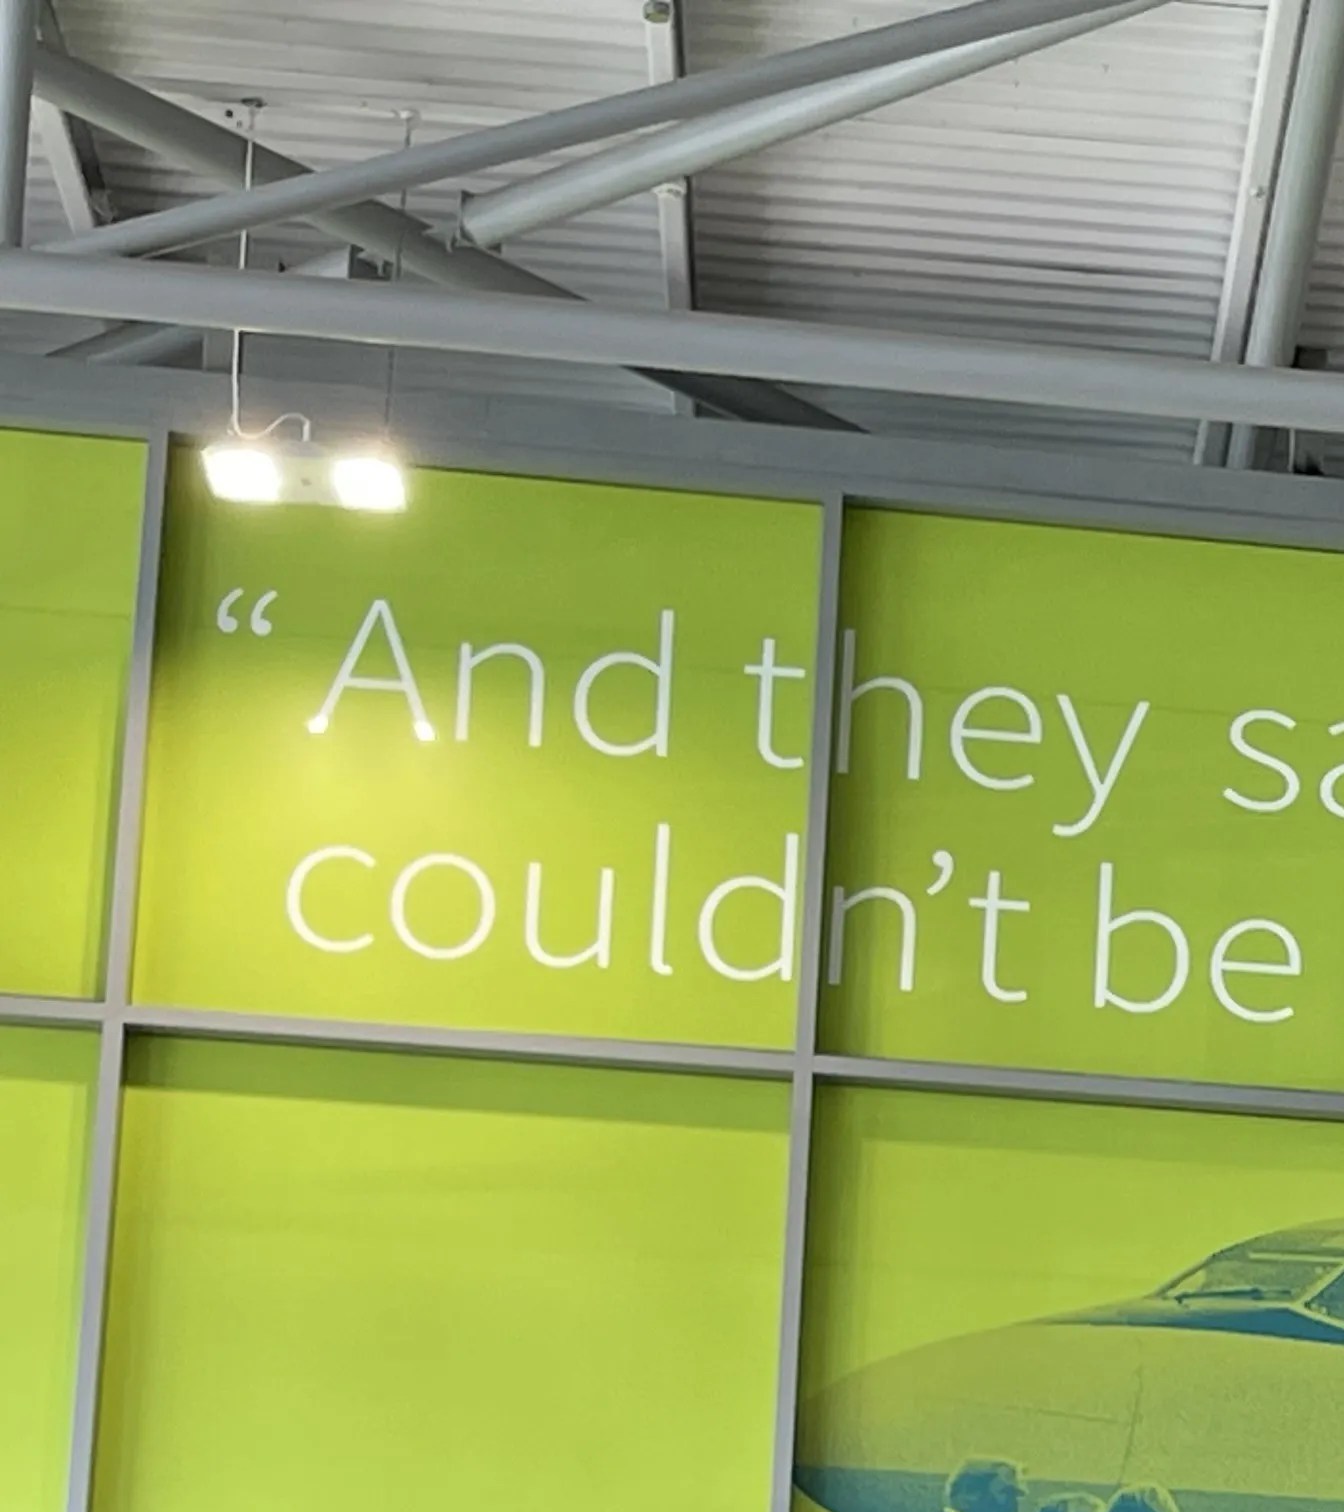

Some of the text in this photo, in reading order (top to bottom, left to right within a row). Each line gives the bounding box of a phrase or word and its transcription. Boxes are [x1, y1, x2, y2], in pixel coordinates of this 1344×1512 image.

[744, 629, 1149, 838] they
[287, 822, 1030, 1003] couldn’t
[1094, 862, 1302, 1023] be
